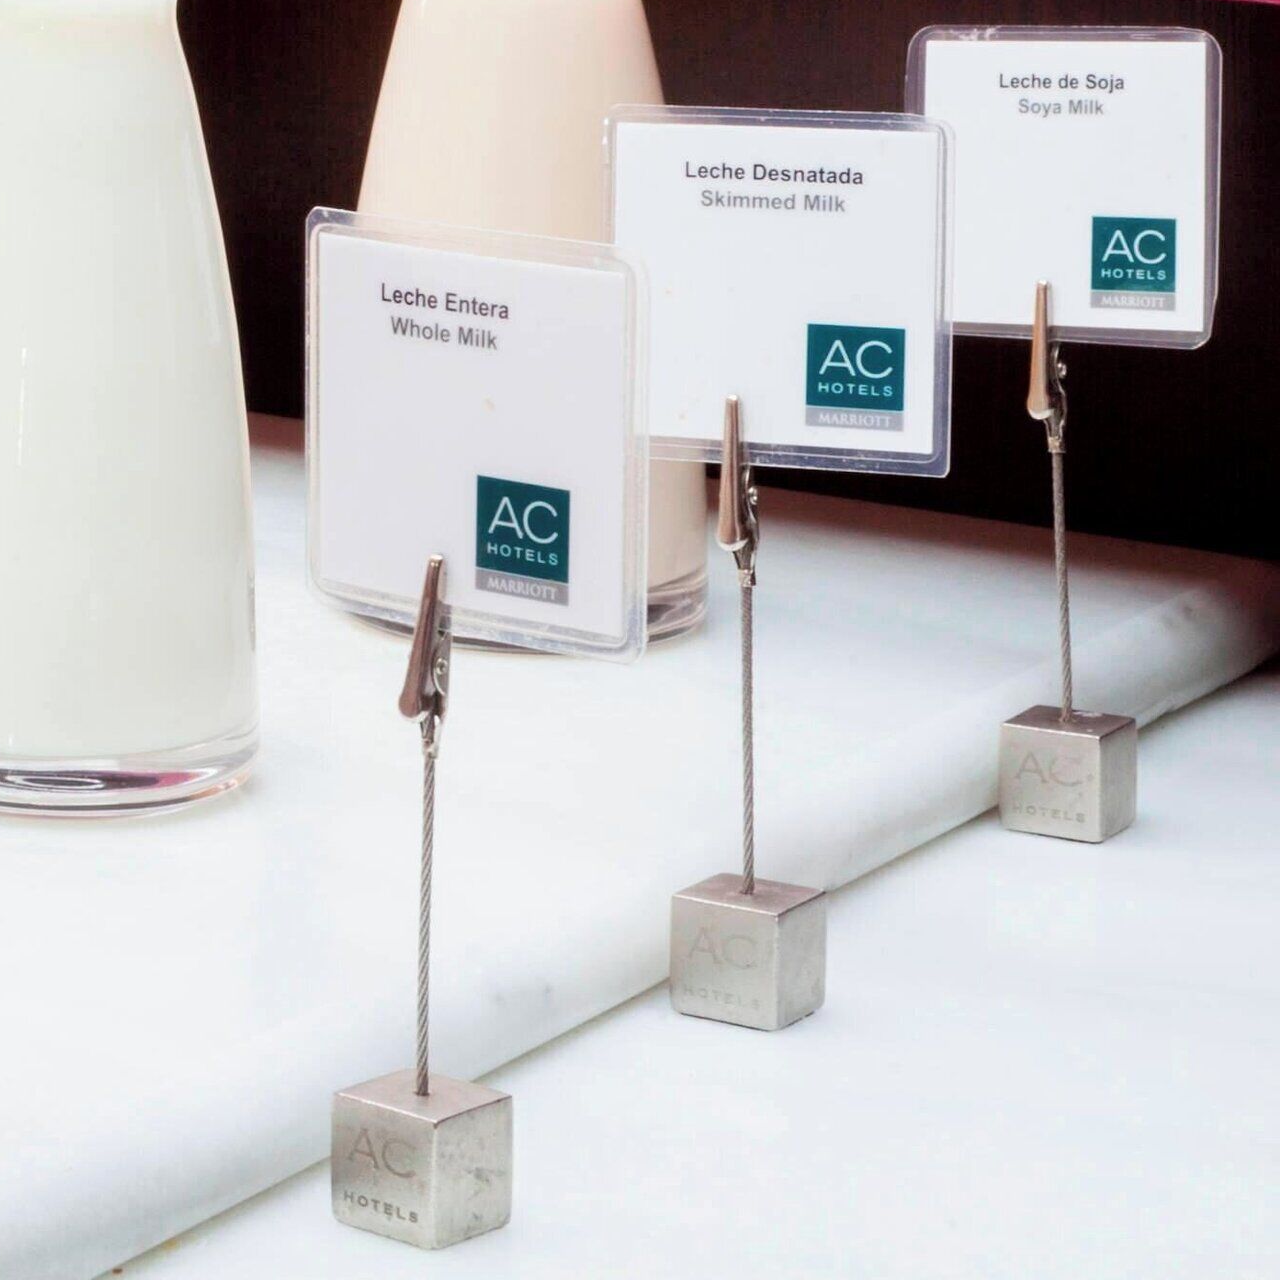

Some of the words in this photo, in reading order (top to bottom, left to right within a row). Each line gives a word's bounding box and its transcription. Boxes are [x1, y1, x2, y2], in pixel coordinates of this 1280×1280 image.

[999, 73, 1052, 89] Leche
[1058, 74, 1079, 89] de
[1086, 74, 1125, 94] Soja
[1018, 99, 1062, 118] Soya
[1069, 100, 1104, 115] Milk
[685, 161, 745, 180] Leche
[753, 164, 864, 185] Desnatada
[701, 190, 796, 210] Skimmed
[804, 195, 846, 213] Milk
[1101, 229, 1167, 264] AC
[1101, 268, 1166, 281] HOTELS
[381, 282, 438, 309] Leche
[445, 292, 509, 320] Entera
[1101, 295, 1165, 308] MARRIOTT
[391, 316, 450, 342] Whole
[458, 326, 497, 350] Milk
[819, 340, 893, 379] AC
[818, 382, 893, 397] HOTELS
[819, 412, 892, 428] MARRIOTT
[488, 496, 558, 544] AC
[487, 542, 558, 566] HOTELS
[487, 577, 557, 600] MARRIOTT
[1015, 751, 1084, 786] AC
[1012, 803, 1086, 823] HOTELS
[687, 927, 758, 969] AC
[348, 1128, 418, 1179] AC
[343, 1190, 419, 1223] HOTELS
